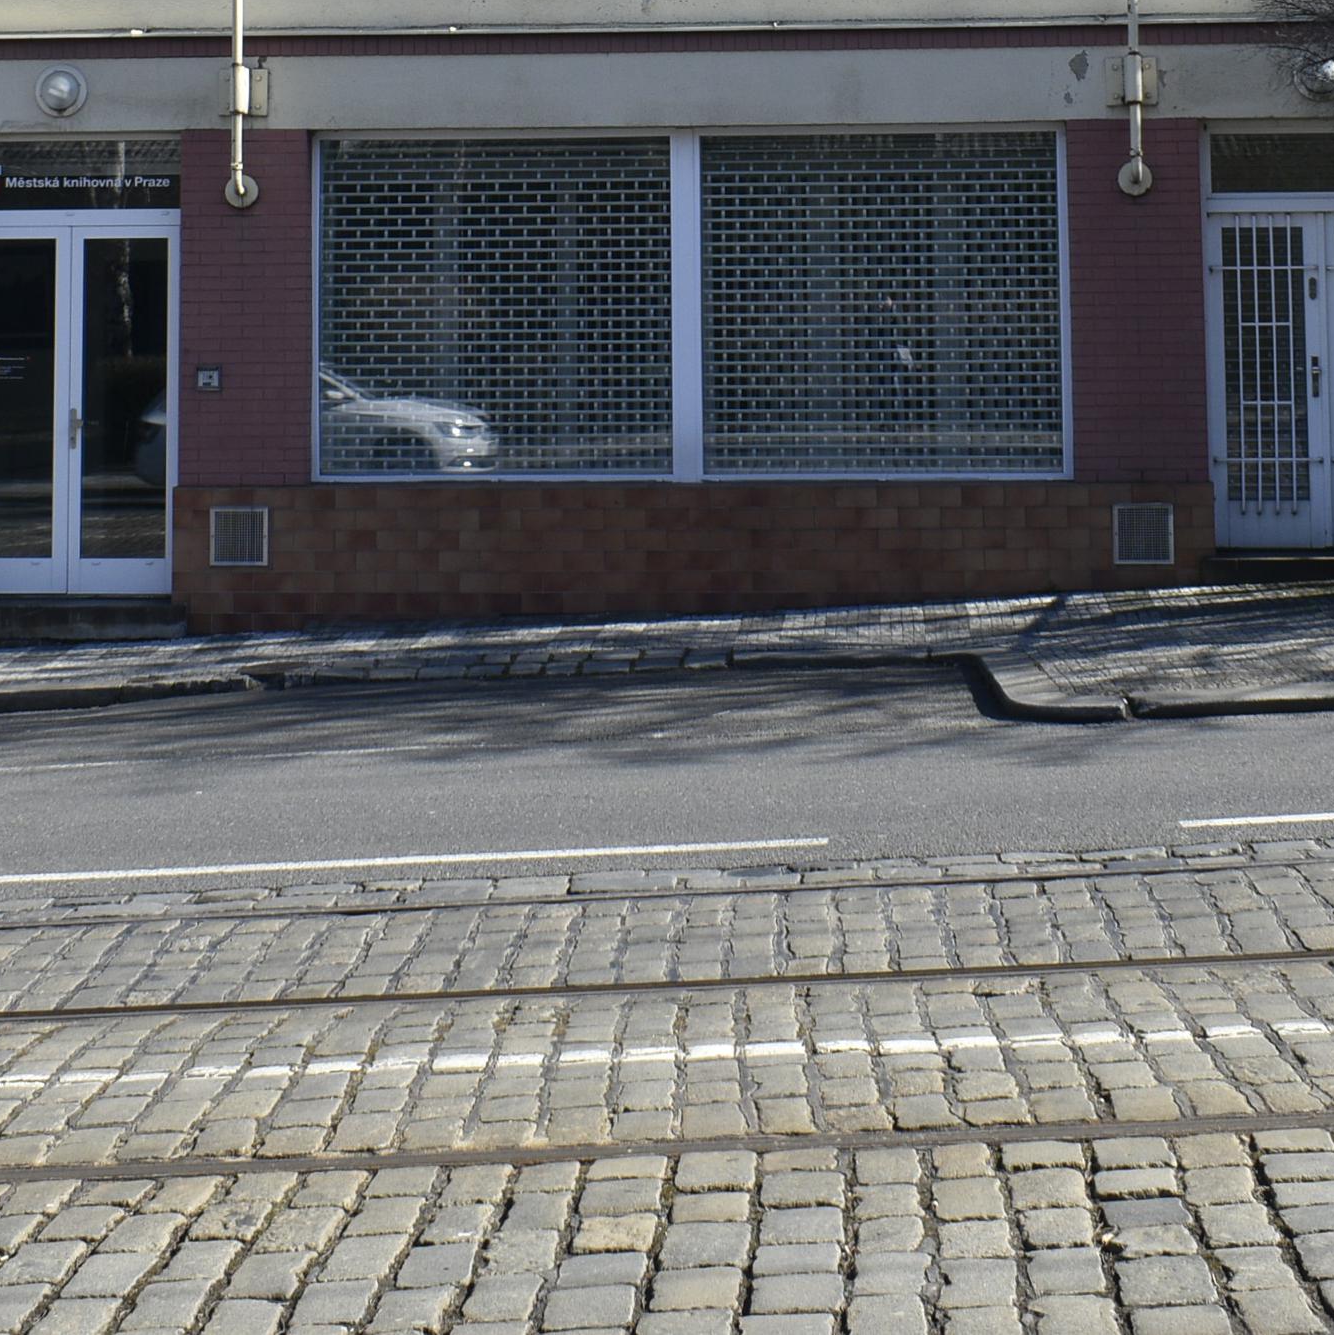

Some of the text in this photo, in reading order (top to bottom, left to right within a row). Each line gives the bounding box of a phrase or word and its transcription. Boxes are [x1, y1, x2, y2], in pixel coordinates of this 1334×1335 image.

[5, 176, 171, 188] Městská knihovna v Praze
